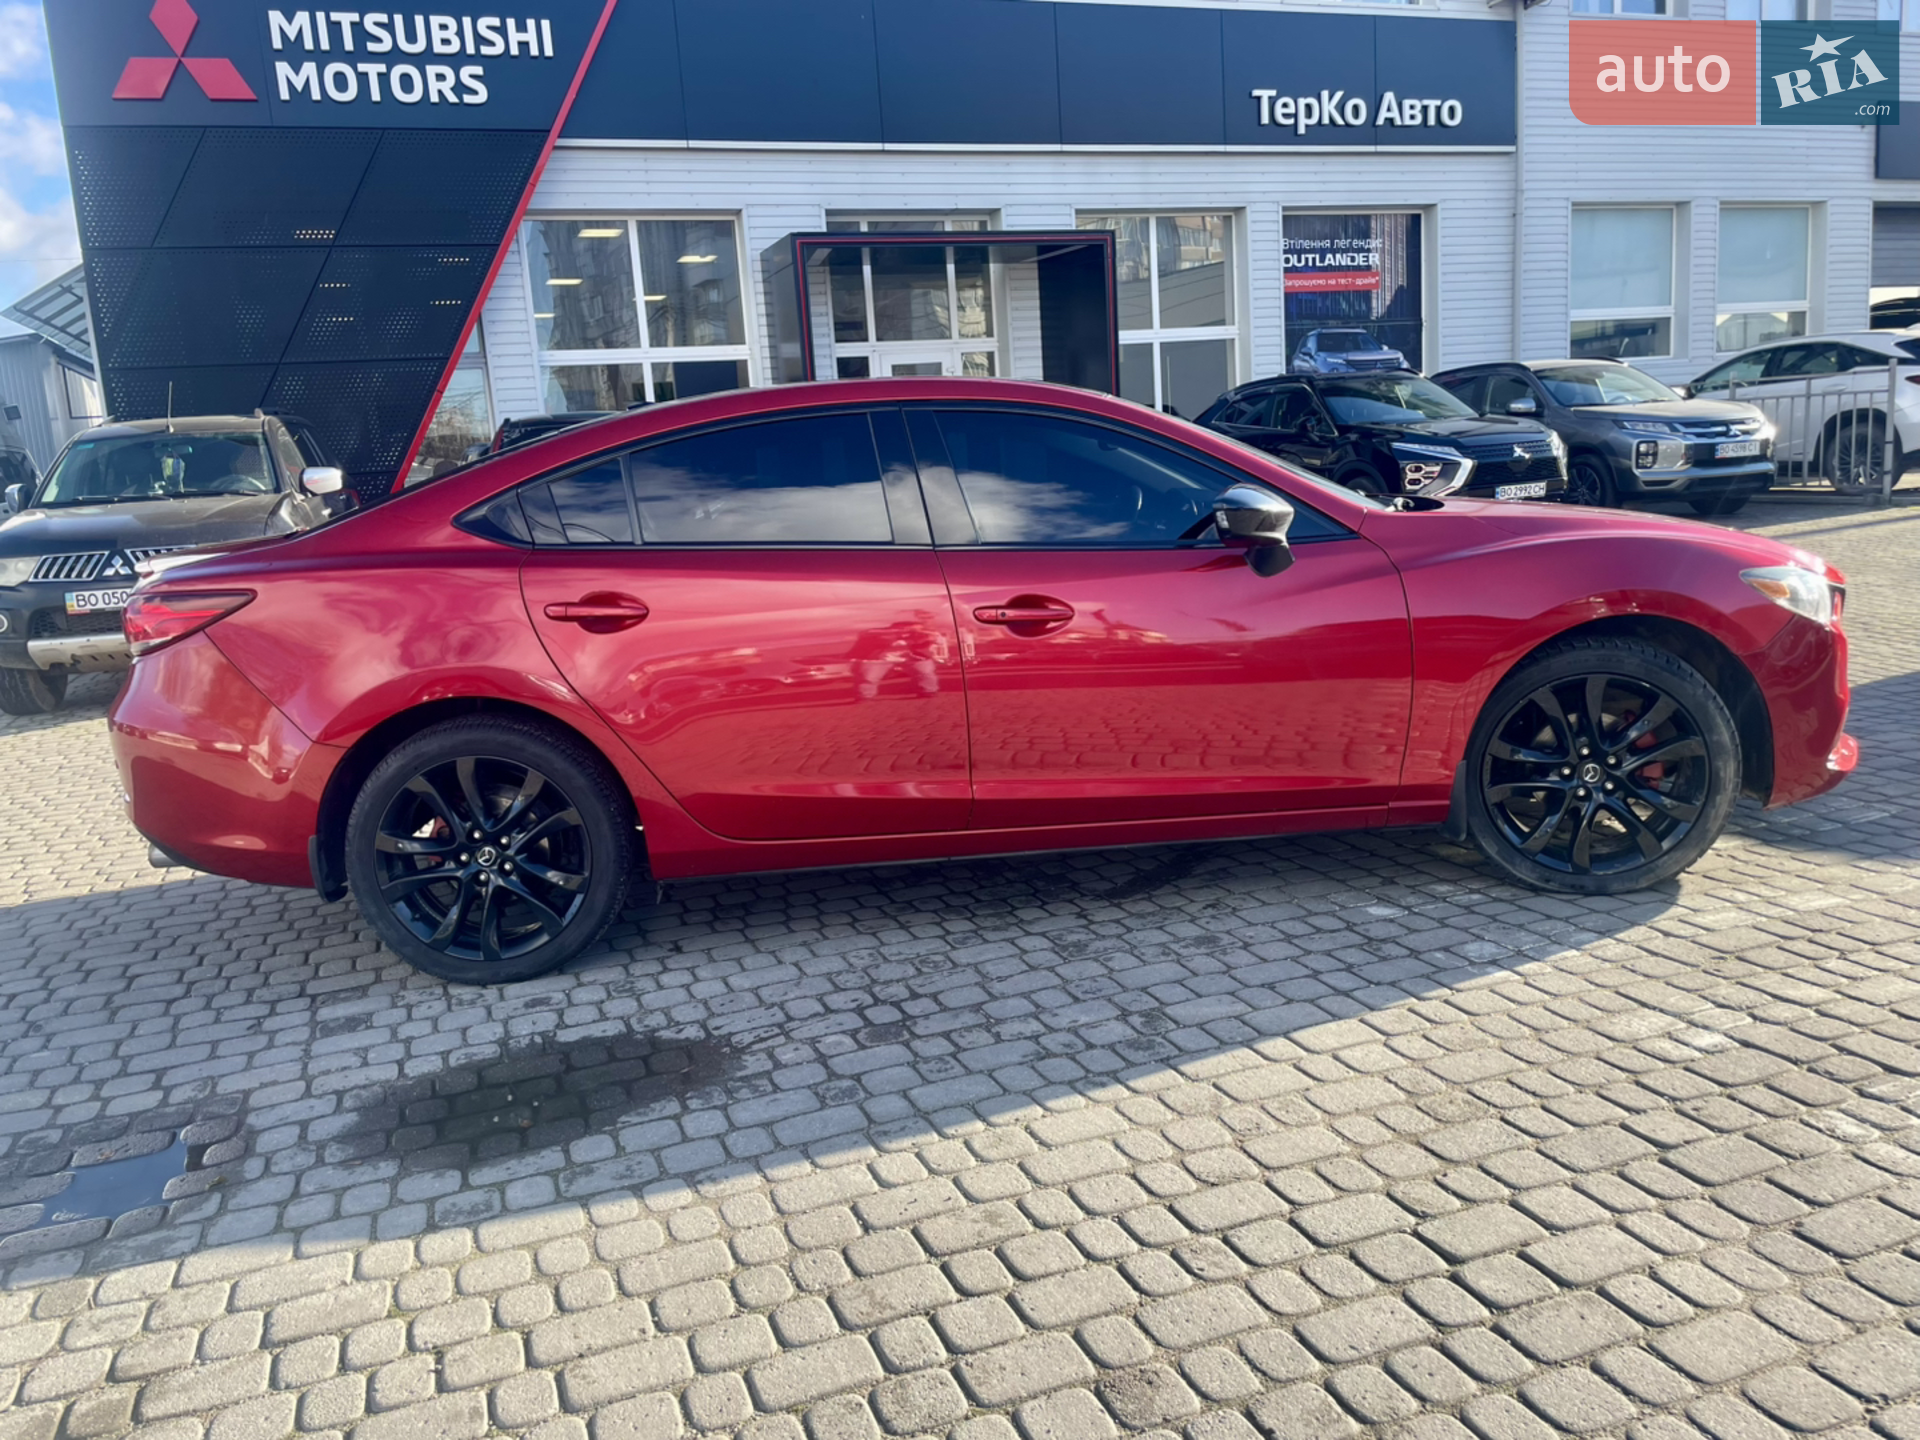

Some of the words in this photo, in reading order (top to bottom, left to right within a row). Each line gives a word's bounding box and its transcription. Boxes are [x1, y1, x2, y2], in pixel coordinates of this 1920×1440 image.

[268, 10, 554, 57] MITSUBISHI
[275, 61, 489, 105] MOTORS
[1251, 89, 1367, 135] ТерКо
[1375, 91, 1463, 127] Авто
[1282, 237, 1330, 249] Втілення
[1282, 252, 1380, 268] OUTLANDER
[1500, 487, 1513, 498] BO
[75, 593, 99, 608] BO
[102, 590, 131, 606] 050
